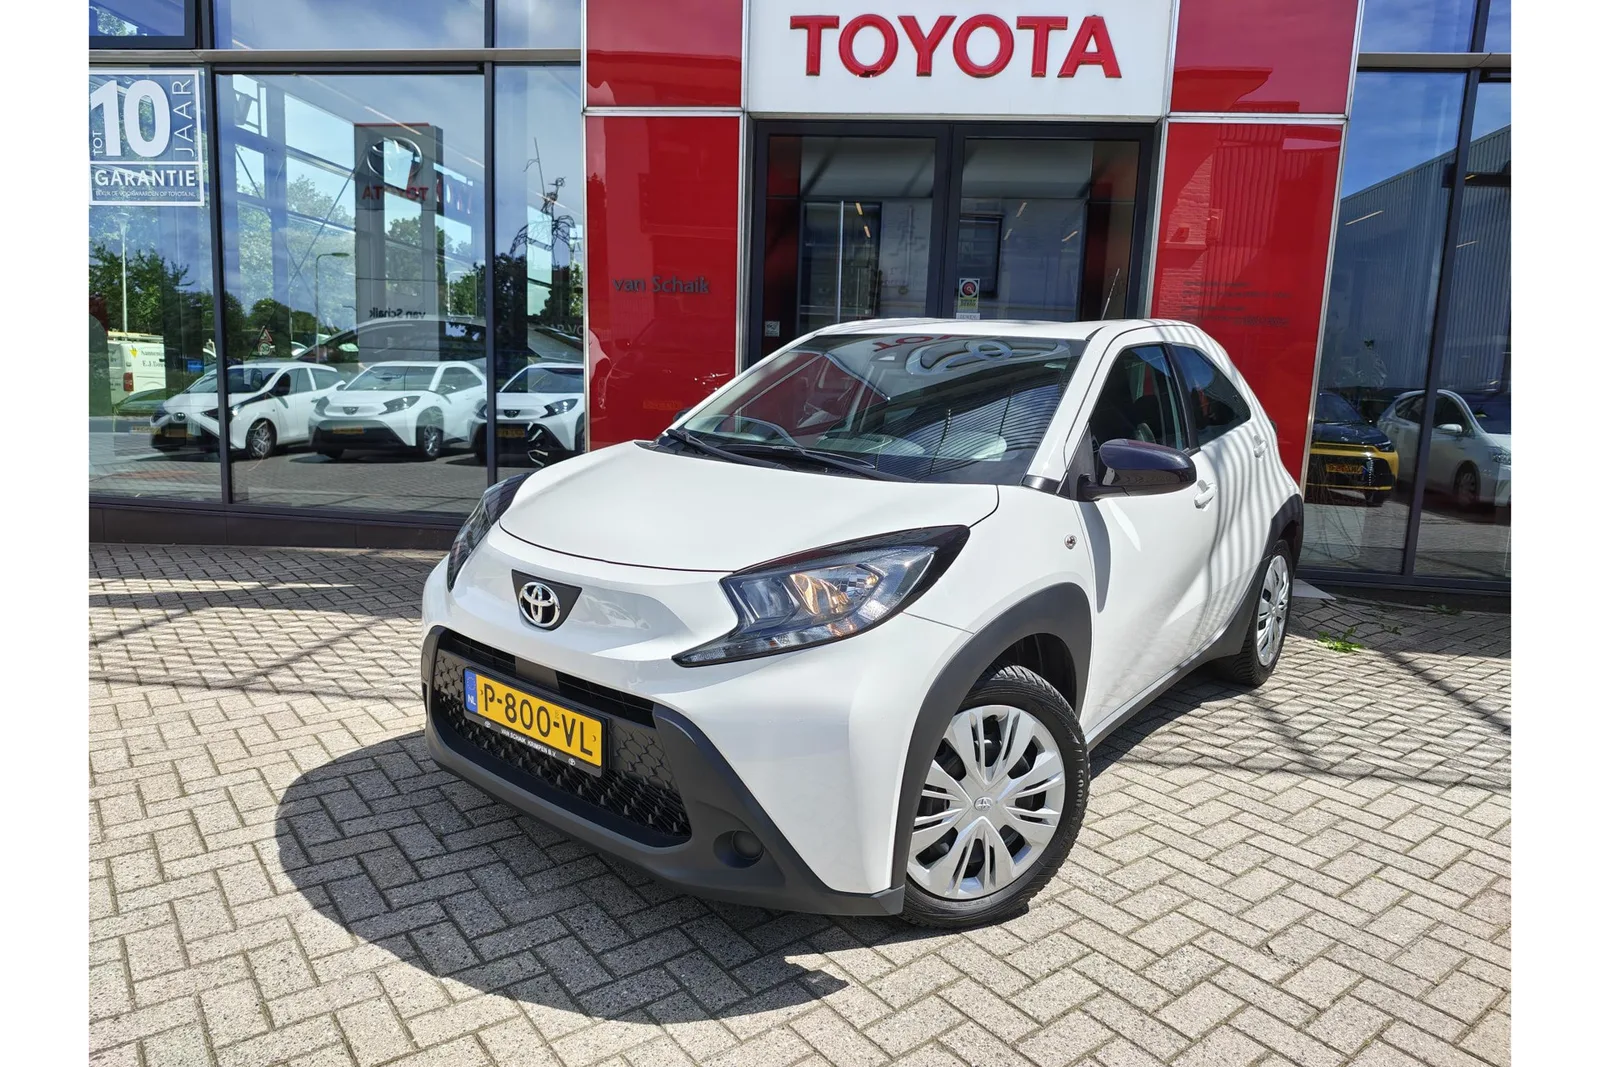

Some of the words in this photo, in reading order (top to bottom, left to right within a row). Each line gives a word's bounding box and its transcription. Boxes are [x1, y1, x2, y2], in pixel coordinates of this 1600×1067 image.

[790, 13, 1122, 79] TOYOTA
[90, 79, 171, 157] 10
[172, 79, 195, 158] JAAR
[92, 130, 103, 156] TOT
[94, 169, 196, 187] GARANTIE
[612, 278, 646, 292] van
[651, 274, 710, 293] Schaik
[467, 693, 477, 706] NL
[484, 683, 593, 757] P-800-VL
